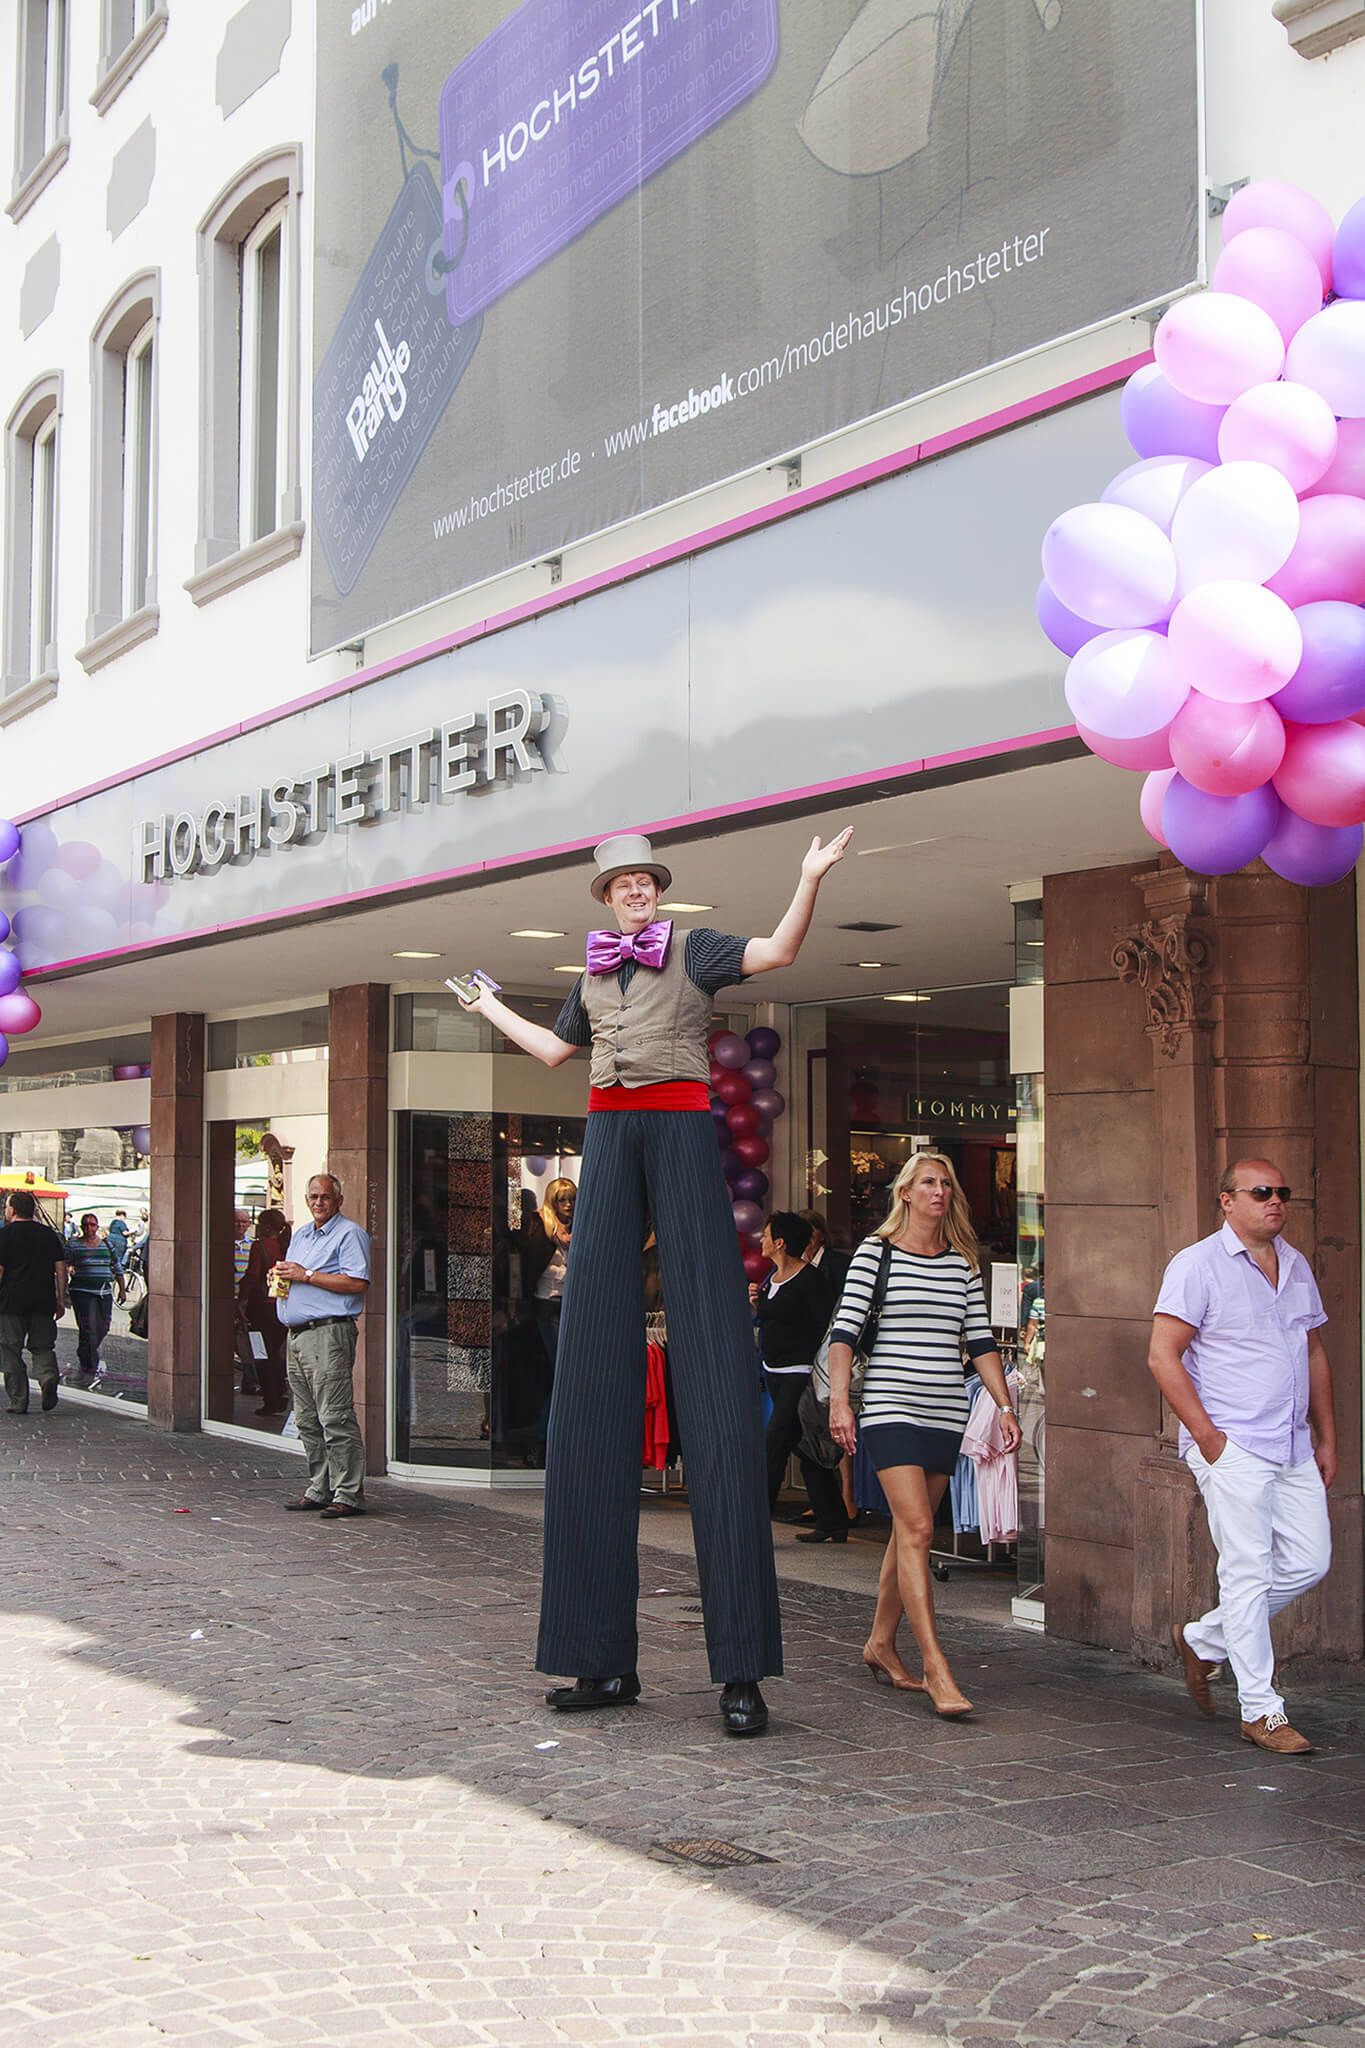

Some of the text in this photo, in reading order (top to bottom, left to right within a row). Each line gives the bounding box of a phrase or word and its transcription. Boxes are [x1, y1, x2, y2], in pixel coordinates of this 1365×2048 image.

[463, 203, 548, 288] Damenmode
[551, 124, 642, 217] Damenmode
[647, 31, 755, 134] Damenmode
[471, 167, 546, 246] amenmode
[549, 83, 642, 177] Damenmode
[481, 0, 697, 187] HOCHSTETT
[432, 226, 1052, 541] www.hochstetter.de www.facebook.com/modehaushochstetter
[138, 688, 548, 883] HOCHSTETTER
[914, 1099, 1001, 1120] TOMMY
